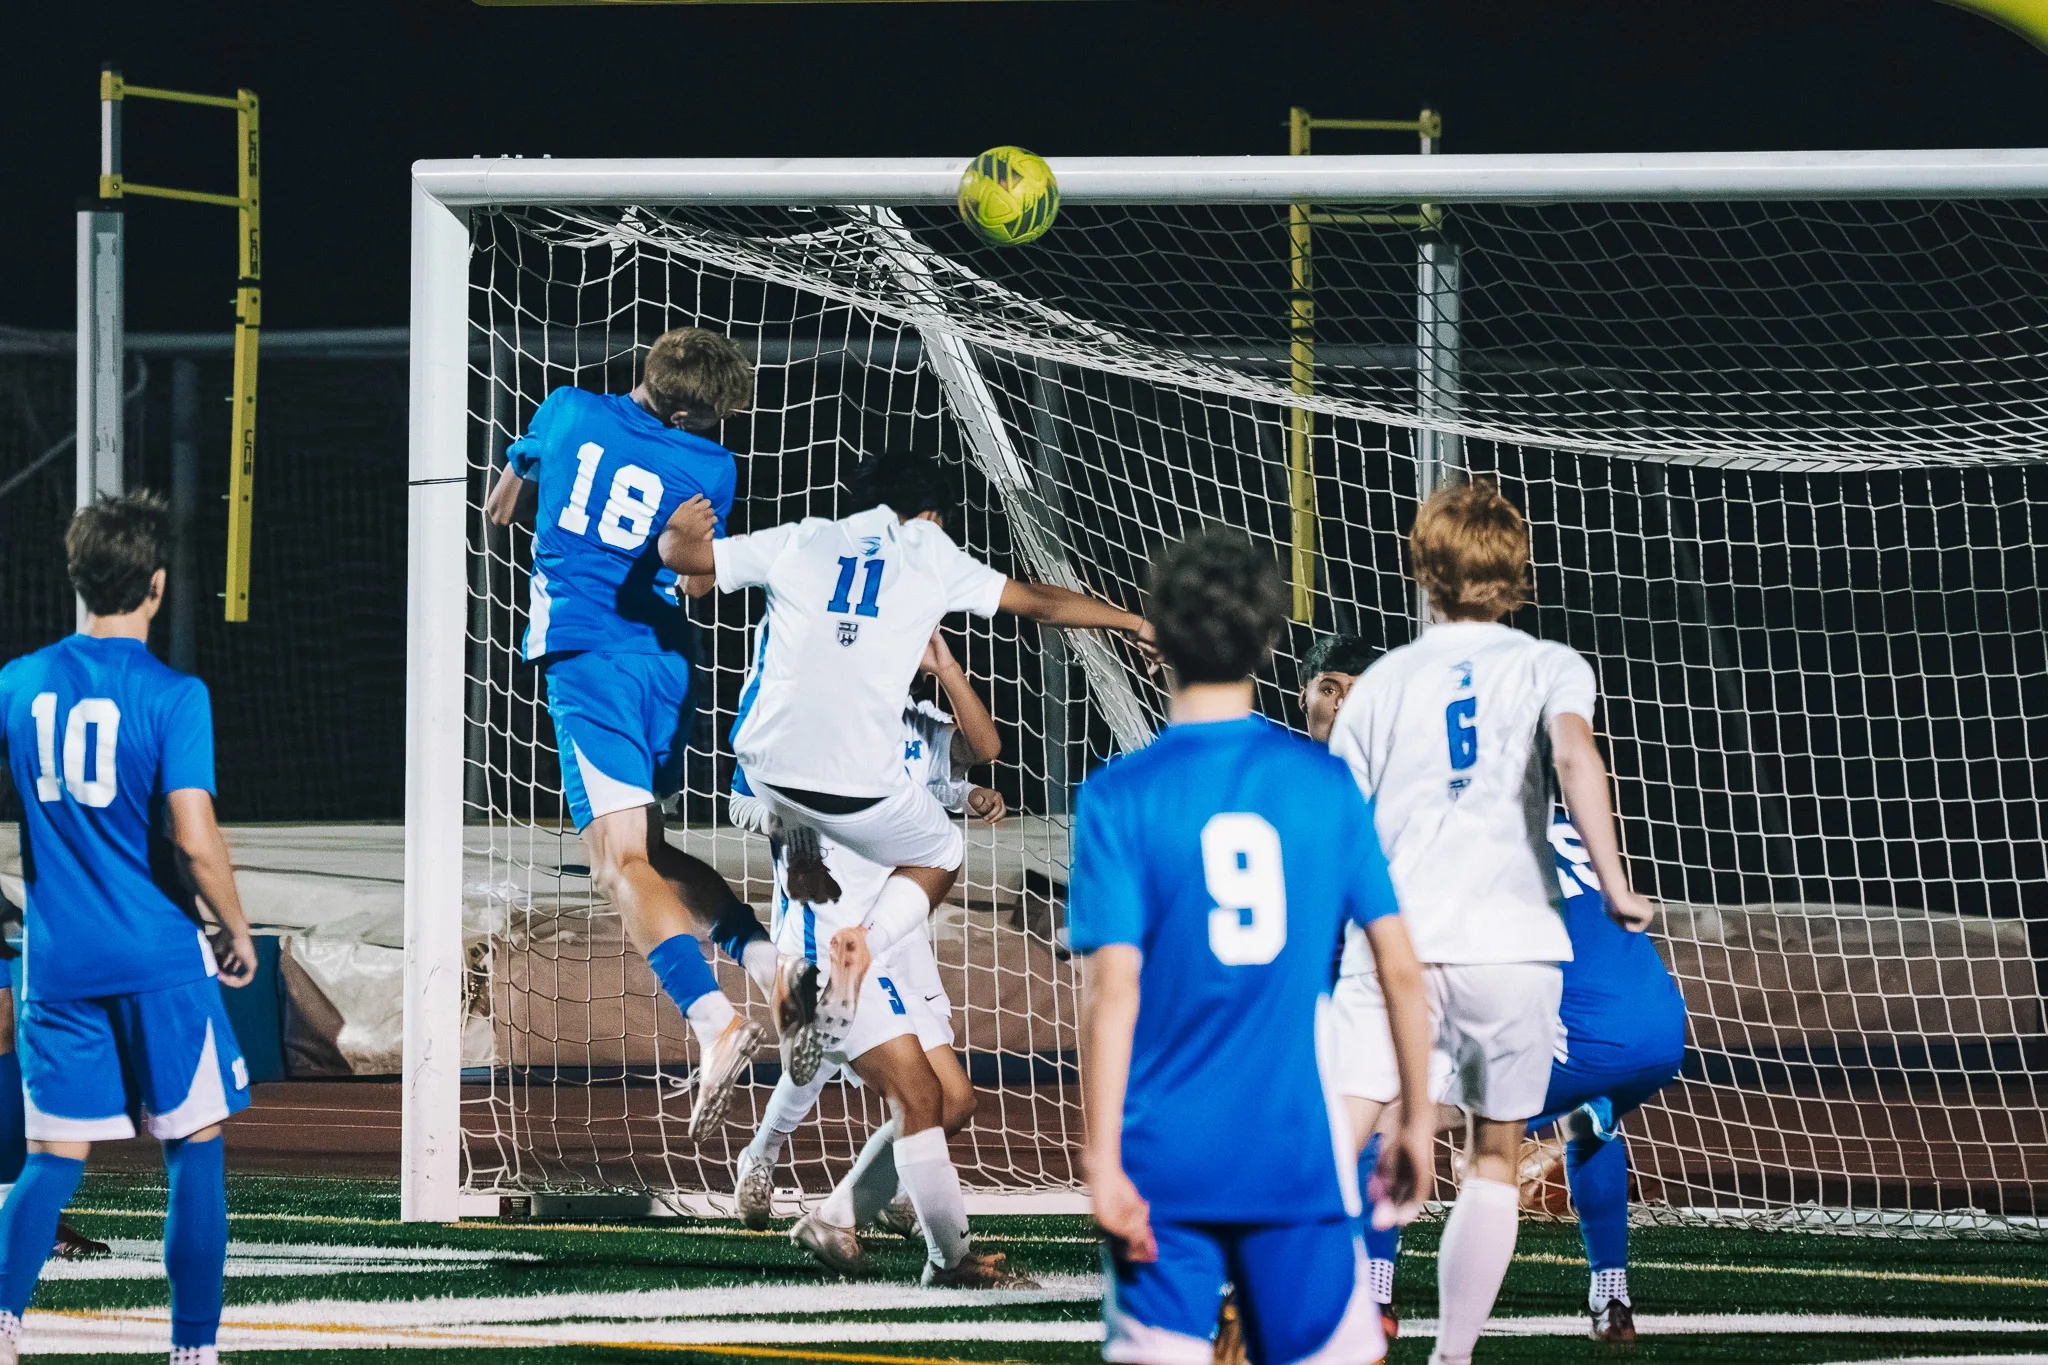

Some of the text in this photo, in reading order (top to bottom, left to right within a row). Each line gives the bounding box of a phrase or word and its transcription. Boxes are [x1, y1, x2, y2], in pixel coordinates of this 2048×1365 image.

[243, 428, 254, 476] UCS
[557, 441, 664, 551] 18
[827, 555, 886, 618] 11
[31, 692, 121, 808] 10
[1446, 696, 1478, 771] 6
[1200, 811, 1288, 967] 9
[877, 976, 907, 1016] 3
